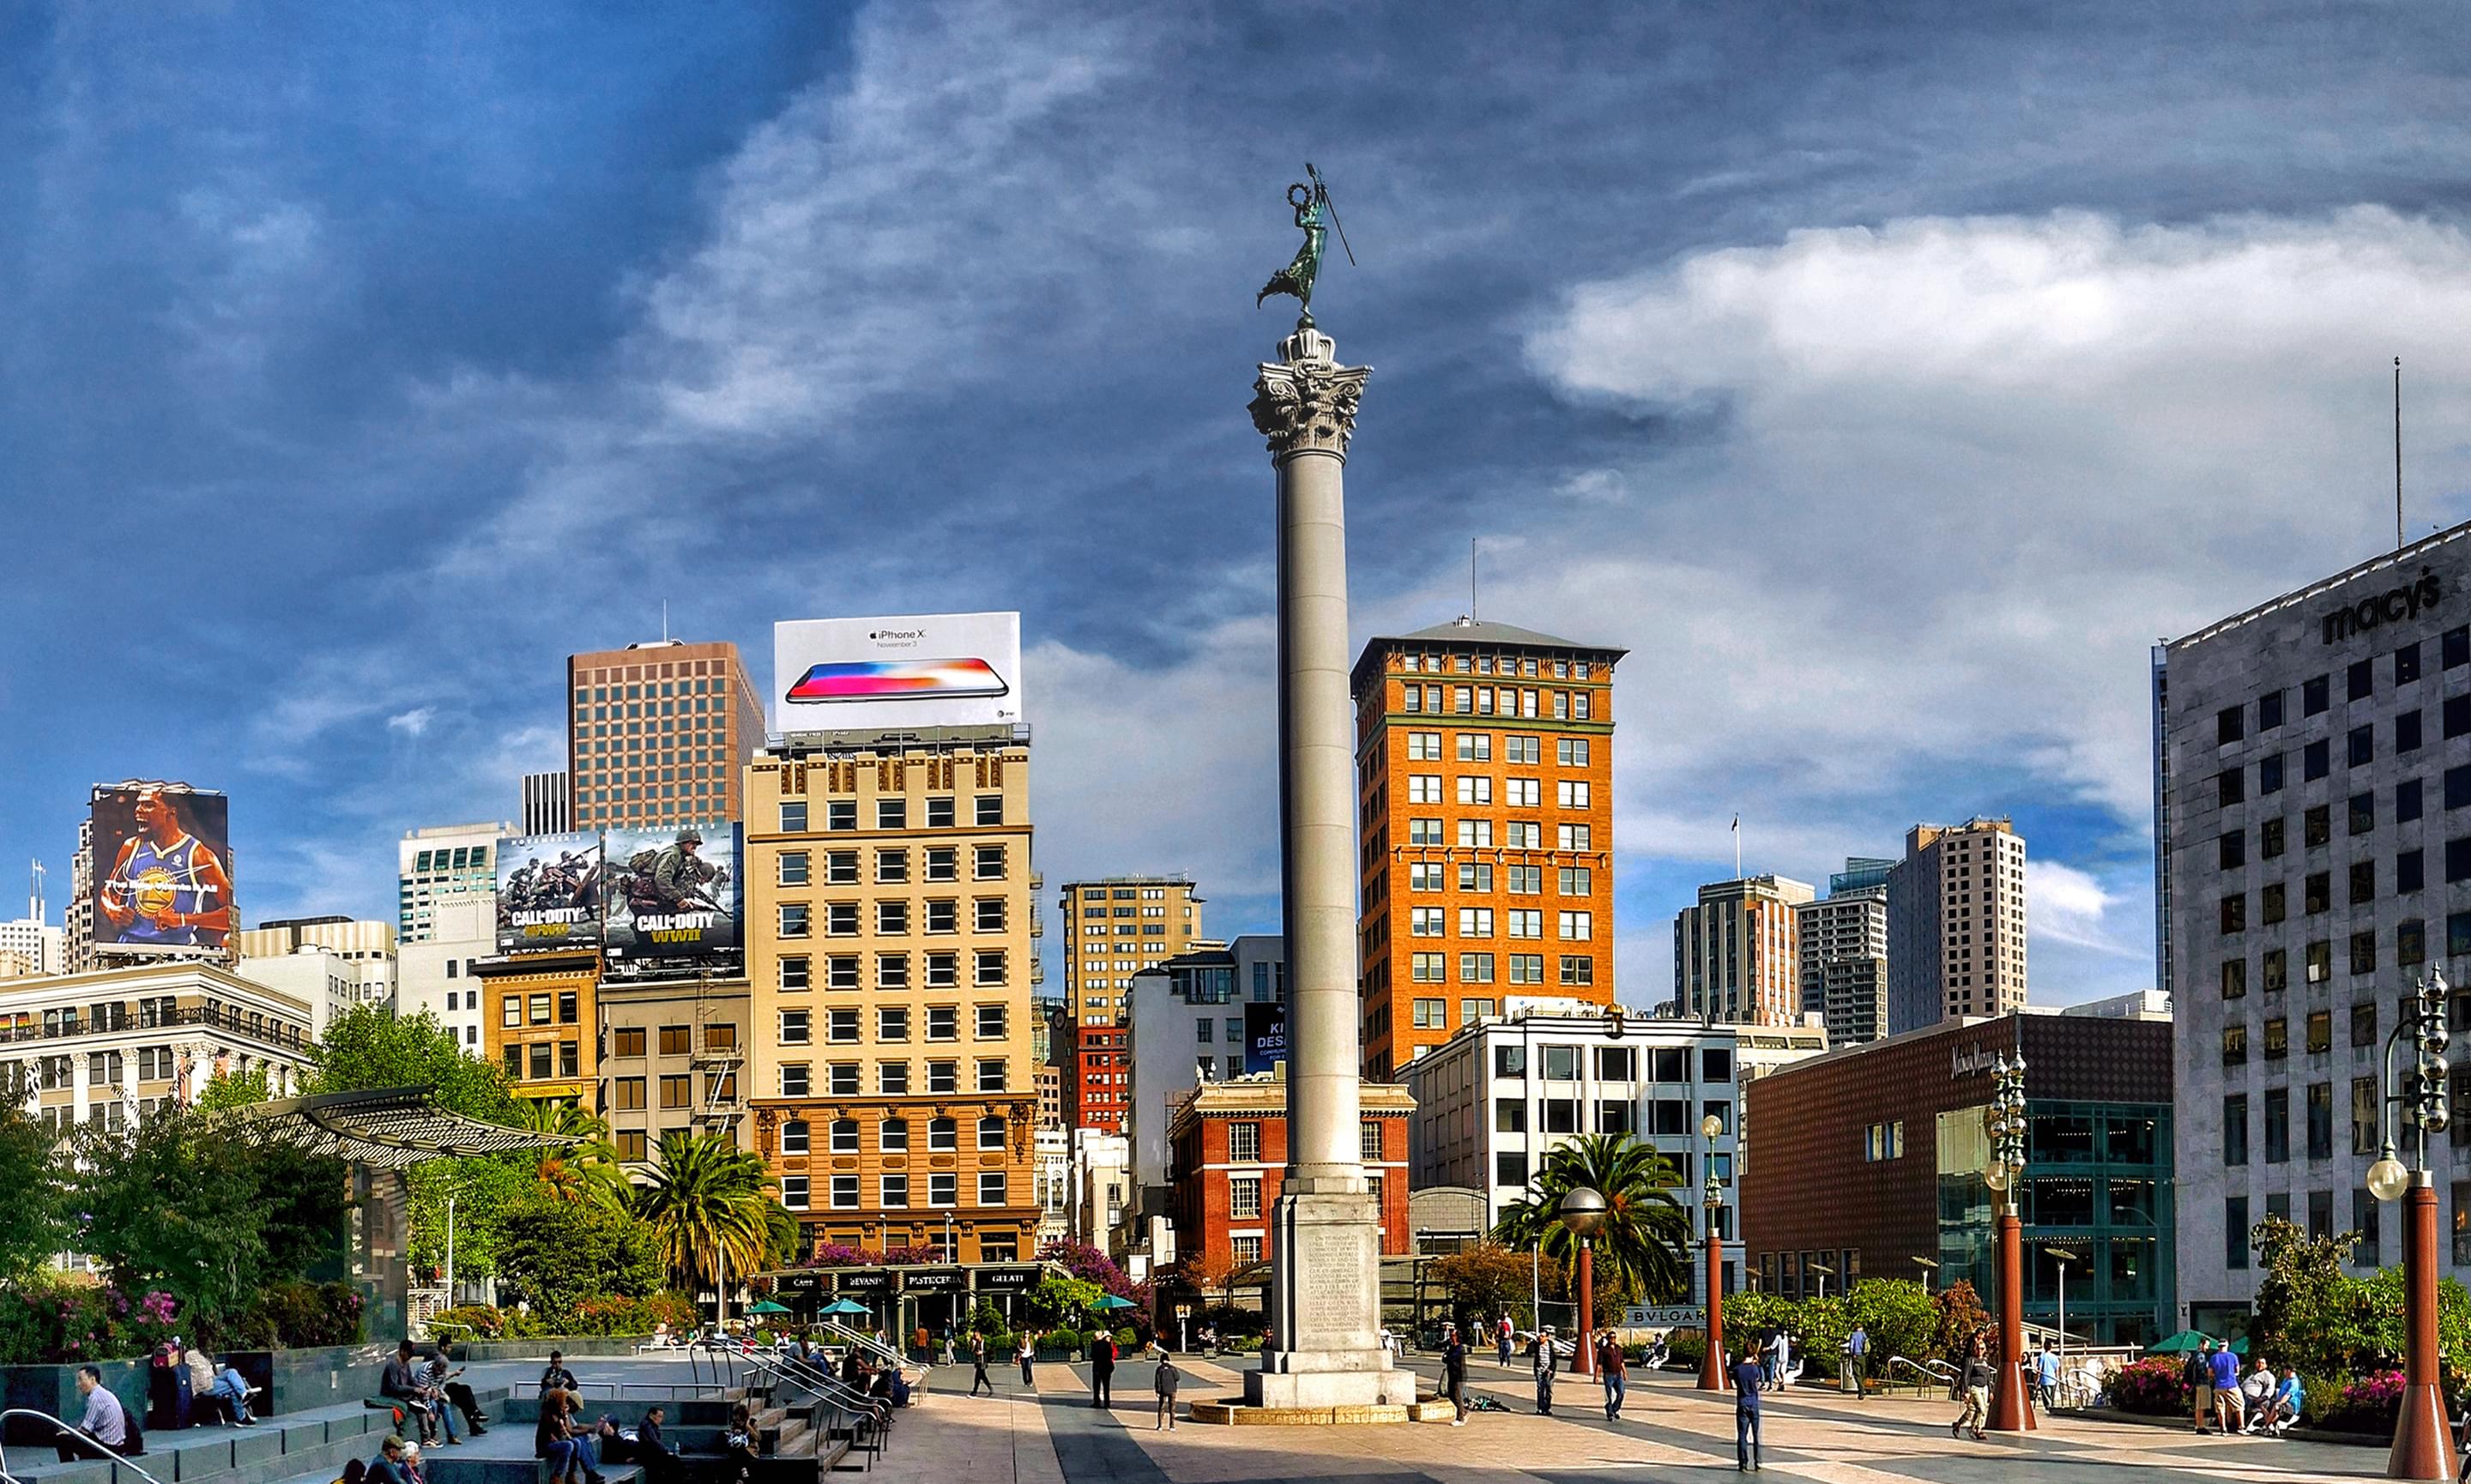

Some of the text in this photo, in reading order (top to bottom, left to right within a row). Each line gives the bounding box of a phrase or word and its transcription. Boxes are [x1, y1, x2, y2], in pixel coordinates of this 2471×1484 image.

[879, 629, 927, 639] iPhone X
[637, 823, 703, 833] NOVEMBER
[511, 835, 569, 846] NOVEMBER
[512, 907, 580, 926] CALL DUTY
[637, 912, 714, 932] CALL DUTY
[651, 929, 701, 943] WWII
[517, 1087, 563, 1097] Needlepoints
[1634, 1310, 1706, 1322] BVLGAR
